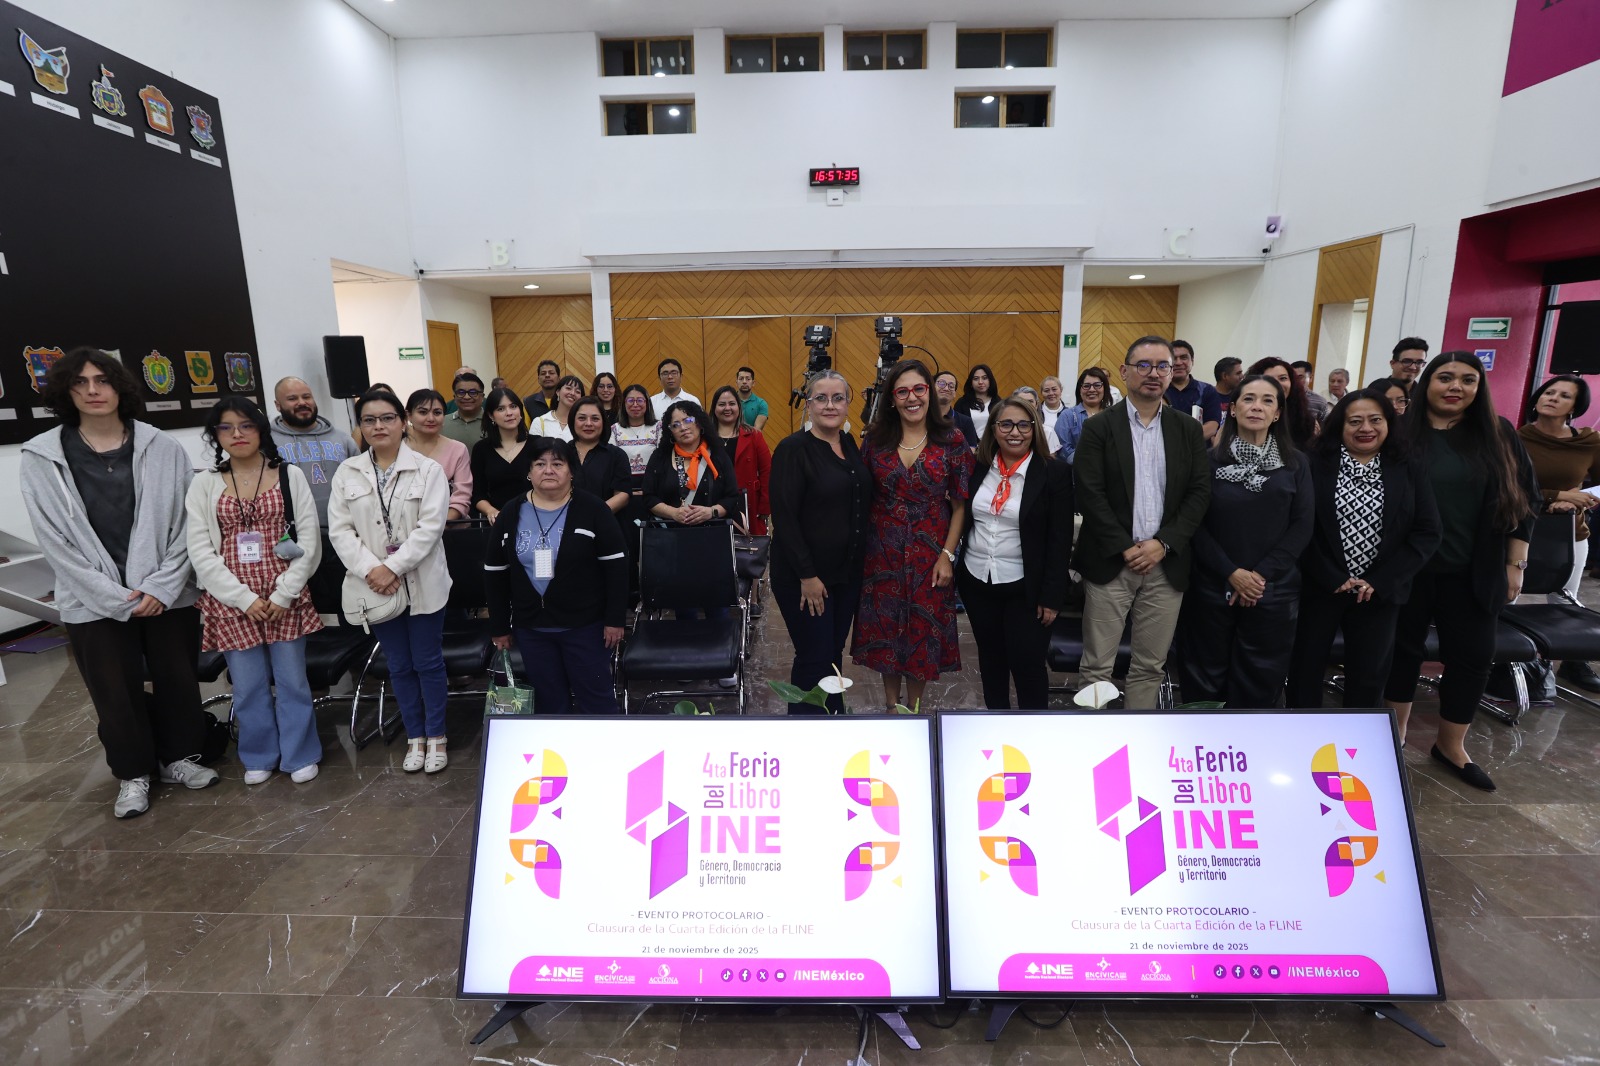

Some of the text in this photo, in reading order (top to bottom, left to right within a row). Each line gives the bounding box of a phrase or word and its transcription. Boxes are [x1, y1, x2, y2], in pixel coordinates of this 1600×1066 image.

[815, 170, 858, 182] 16:57:35
[1169, 229, 1188, 256] C
[492, 242, 509, 266] B
[702, 751, 780, 778] 4ta Feria
[1169, 745, 1248, 772] 4ta Feria
[703, 782, 780, 809] Del Libro
[1171, 776, 1252, 804] Del Libro
[701, 816, 781, 853] INE
[1173, 810, 1258, 849] INE
[700, 860, 781, 872] Género, Democracia
[1178, 854, 1261, 868] Género, Democracia
[699, 874, 746, 887] y Territorio
[1179, 869, 1227, 884] y Territorio
[638, 911, 679, 920] EVENTO
[682, 911, 764, 920] PROTOCOLARIO
[1121, 907, 1163, 915] EVENTO
[1166, 907, 1249, 916] PROTOCOLARIO
[587, 922, 814, 934] Clausura de la Cuarta Edición de la FLINE
[1071, 920, 1303, 931] Clausura de la Cuarta Edición de la FLINE
[668, 946, 720, 954] noviembre
[723, 946, 734, 954] de
[738, 946, 758, 954] 2025
[1157, 942, 1209, 950] noviembre
[1212, 942, 1224, 950] de
[1227, 943, 1249, 951] 2025
[553, 967, 584, 978] INE
[1042, 964, 1073, 974] INE
[1287, 966, 1360, 978] /INEMéxico
[793, 970, 865, 981] /INEMéxico
